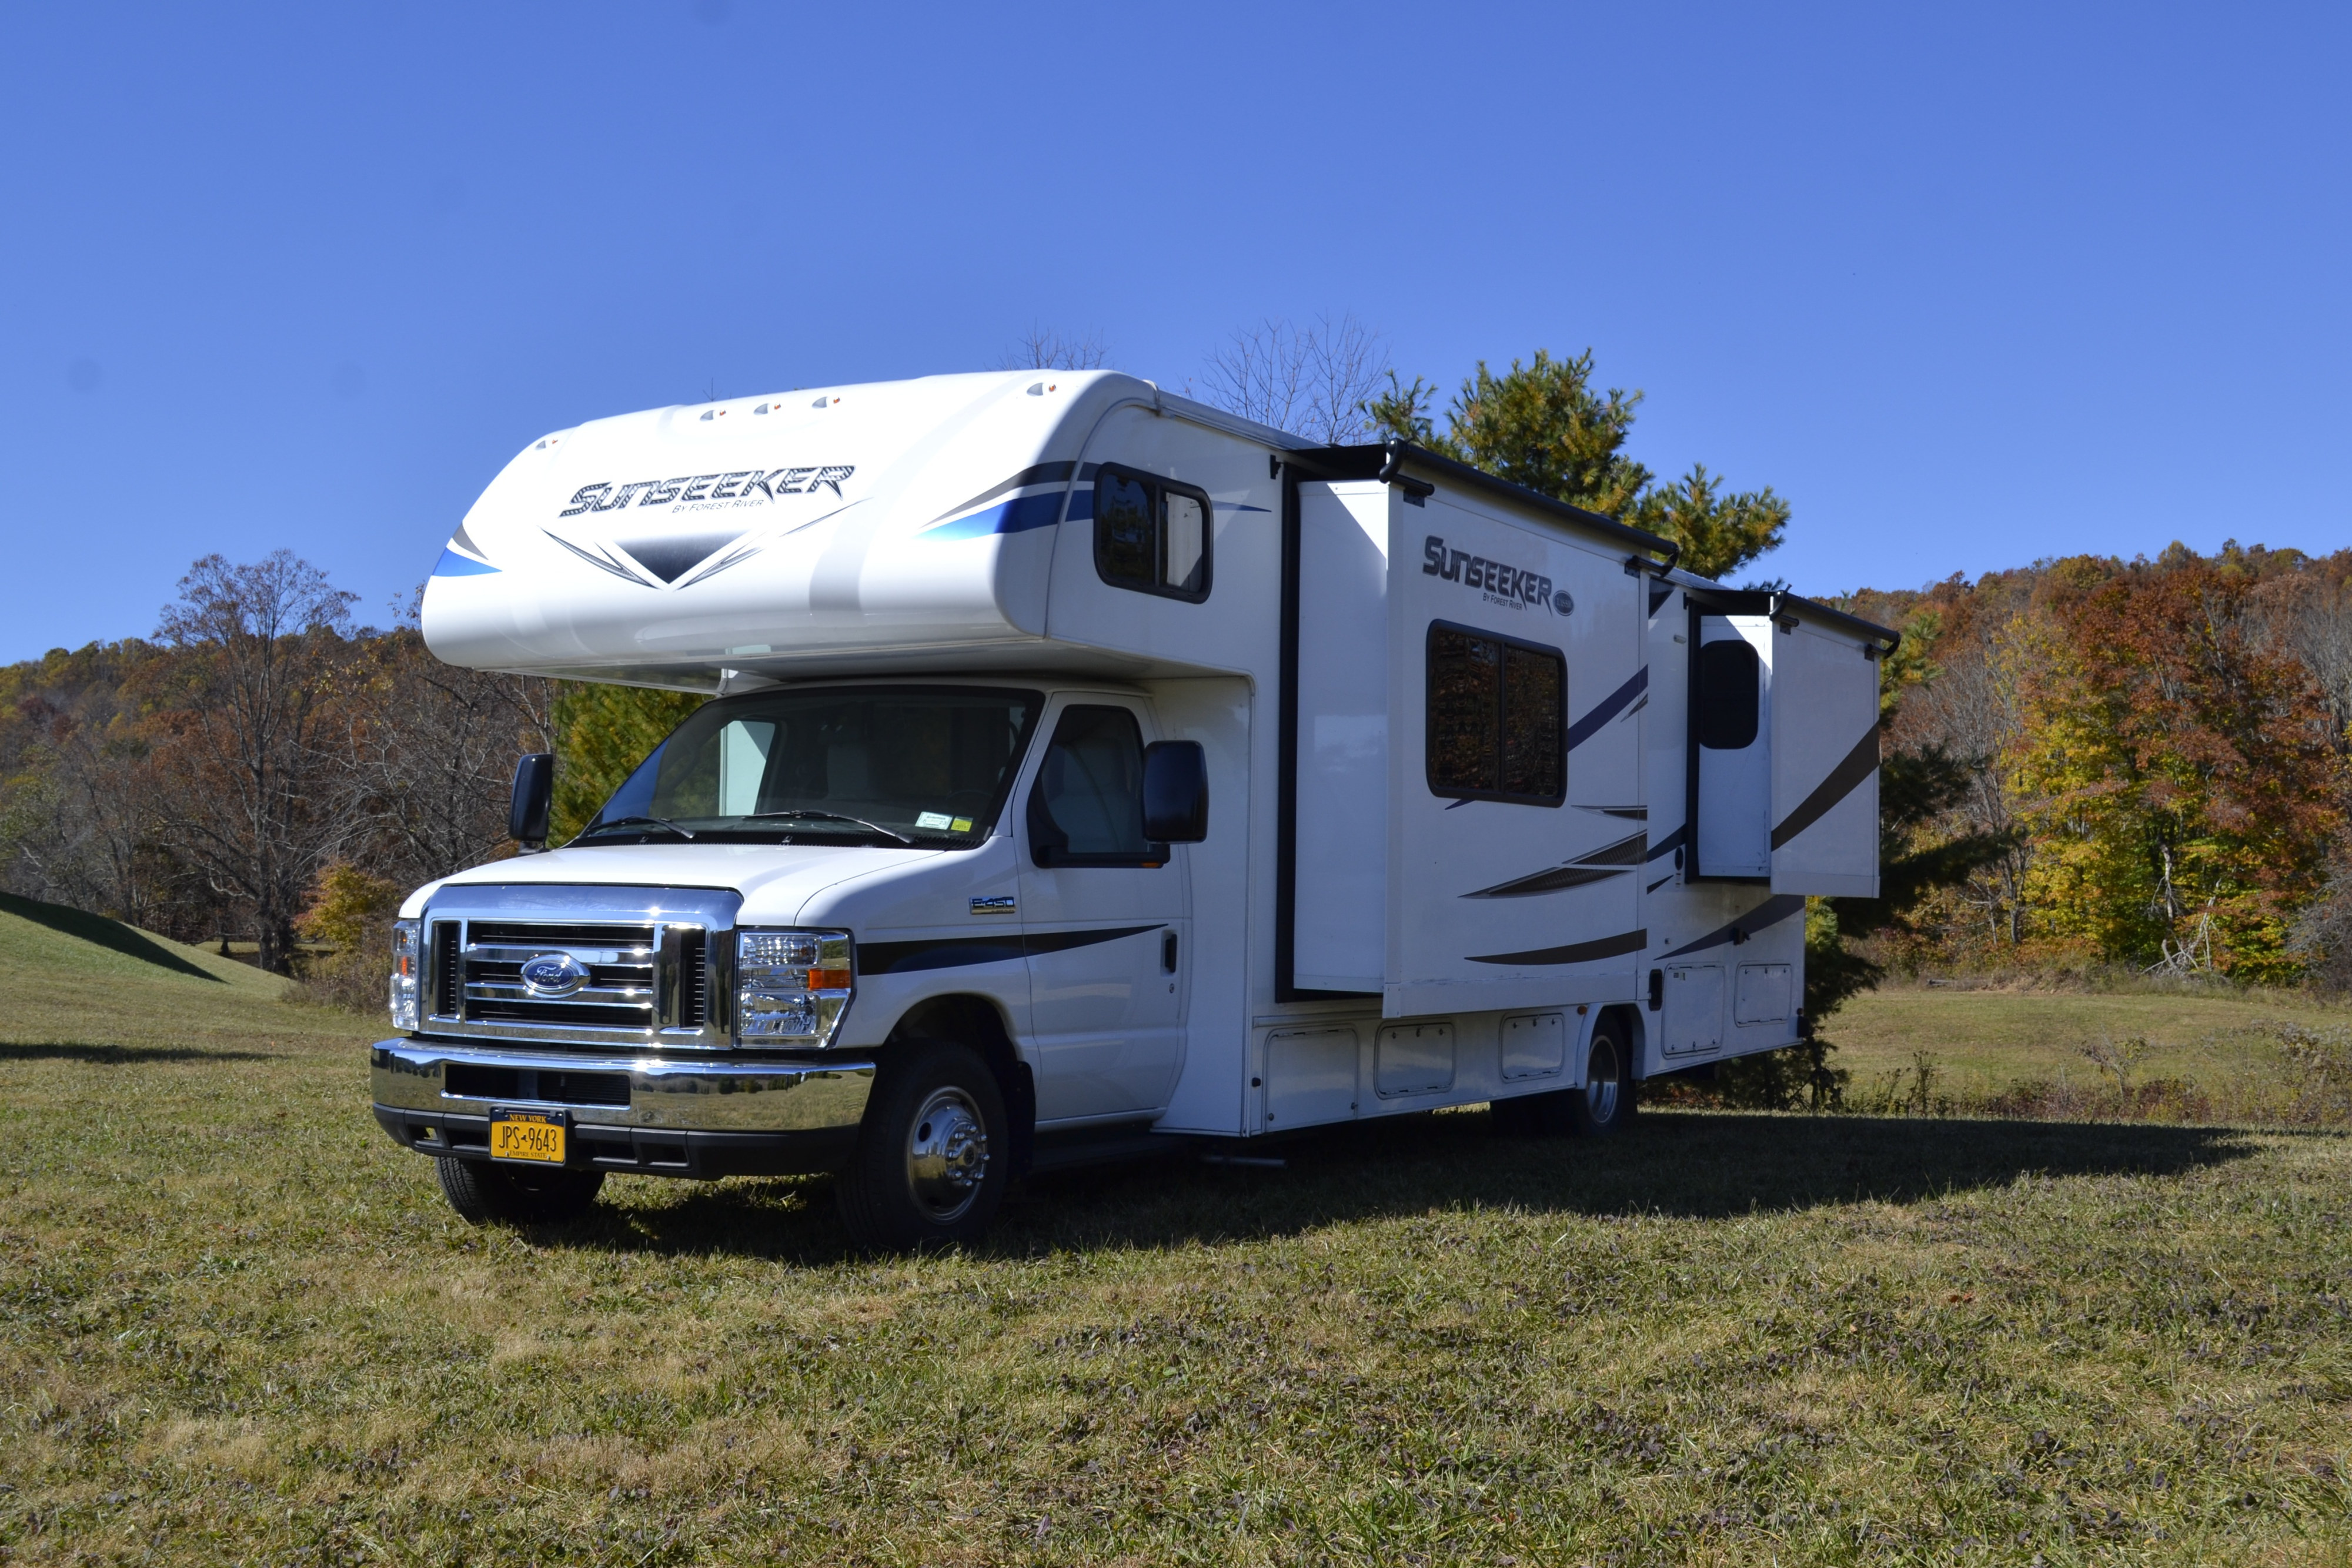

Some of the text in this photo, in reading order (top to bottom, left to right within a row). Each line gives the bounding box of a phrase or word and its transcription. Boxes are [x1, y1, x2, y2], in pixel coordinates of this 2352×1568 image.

[689, 502, 731, 511] FOREST
[731, 499, 764, 508] RIVER
[1490, 594, 1508, 607] FOREST
[1509, 600, 1522, 611] RIVER
[533, 965, 563, 983] Ford
[509, 1114, 546, 1123] NEW YORK
